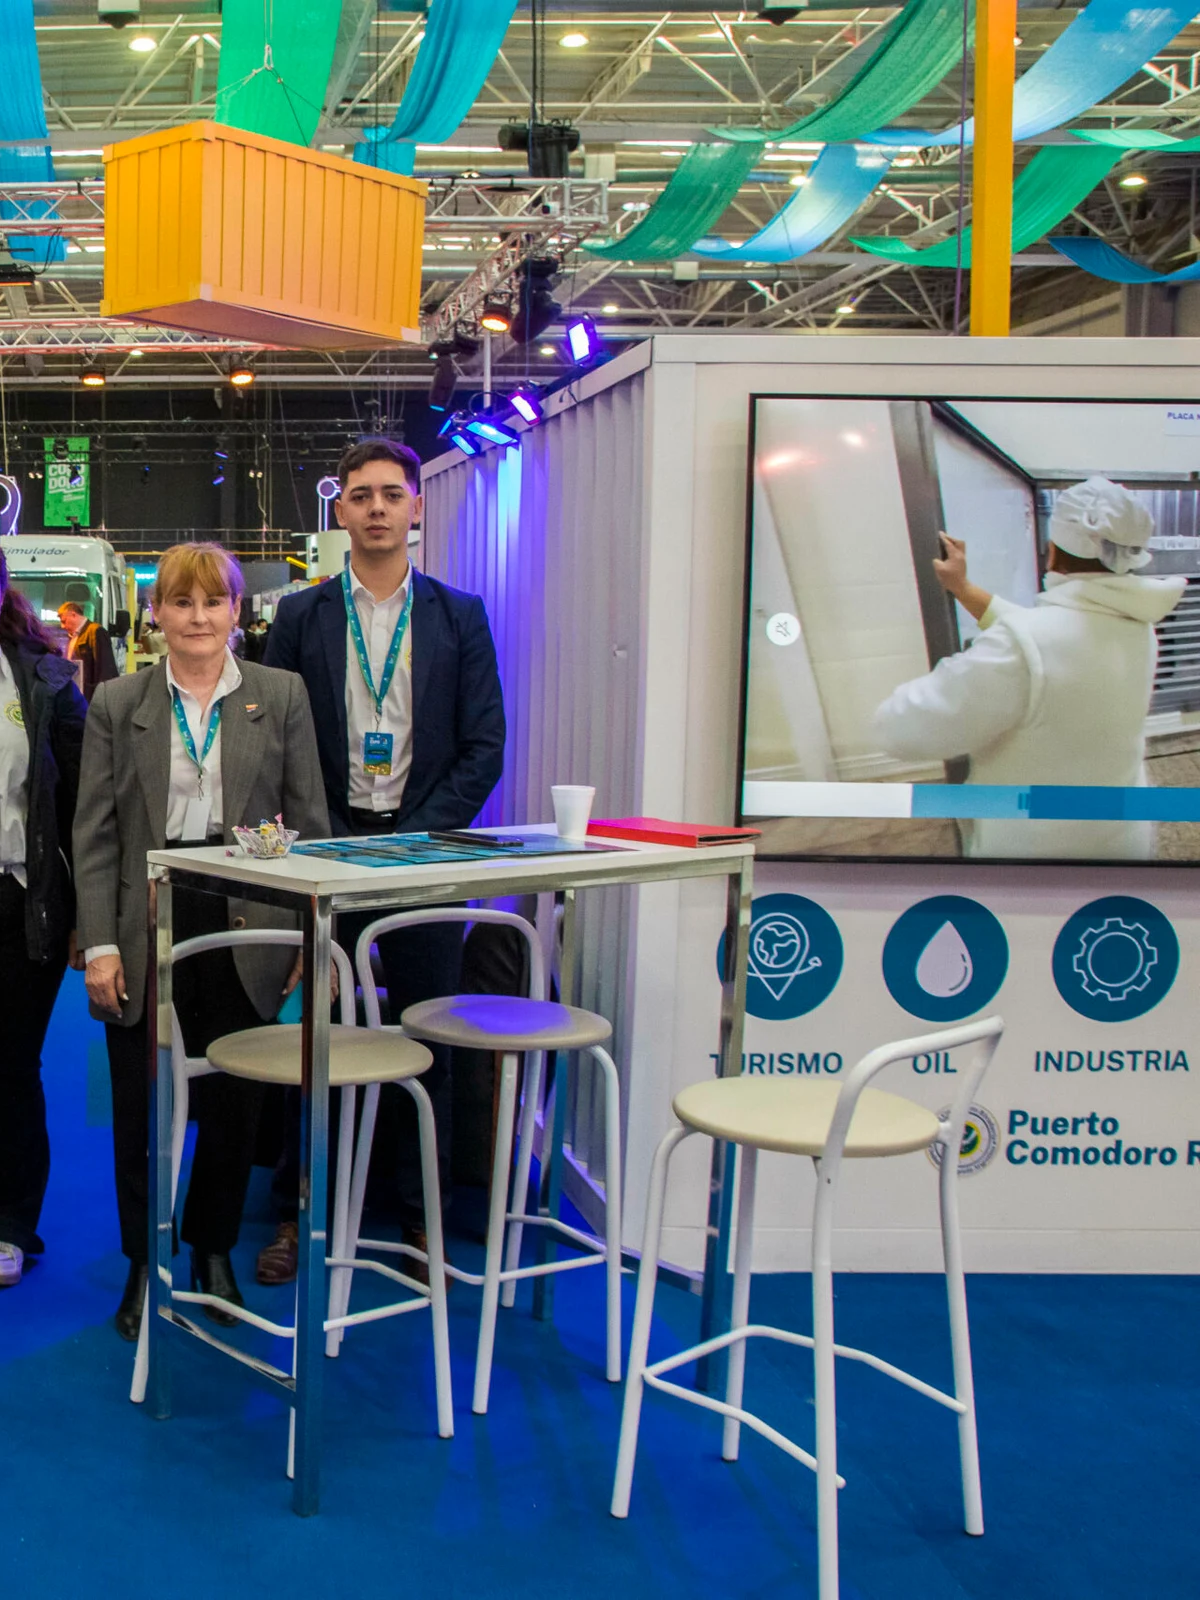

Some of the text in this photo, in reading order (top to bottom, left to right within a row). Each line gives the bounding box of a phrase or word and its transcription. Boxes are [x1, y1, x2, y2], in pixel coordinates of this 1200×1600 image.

[1167, 411, 1194, 420] PLACA
[912, 1052, 957, 1074] OIL
[1034, 1050, 1189, 1072] INDUSTRIA
[1008, 1109, 1120, 1136] Puerto
[1006, 1139, 1178, 1166] Comodoro
